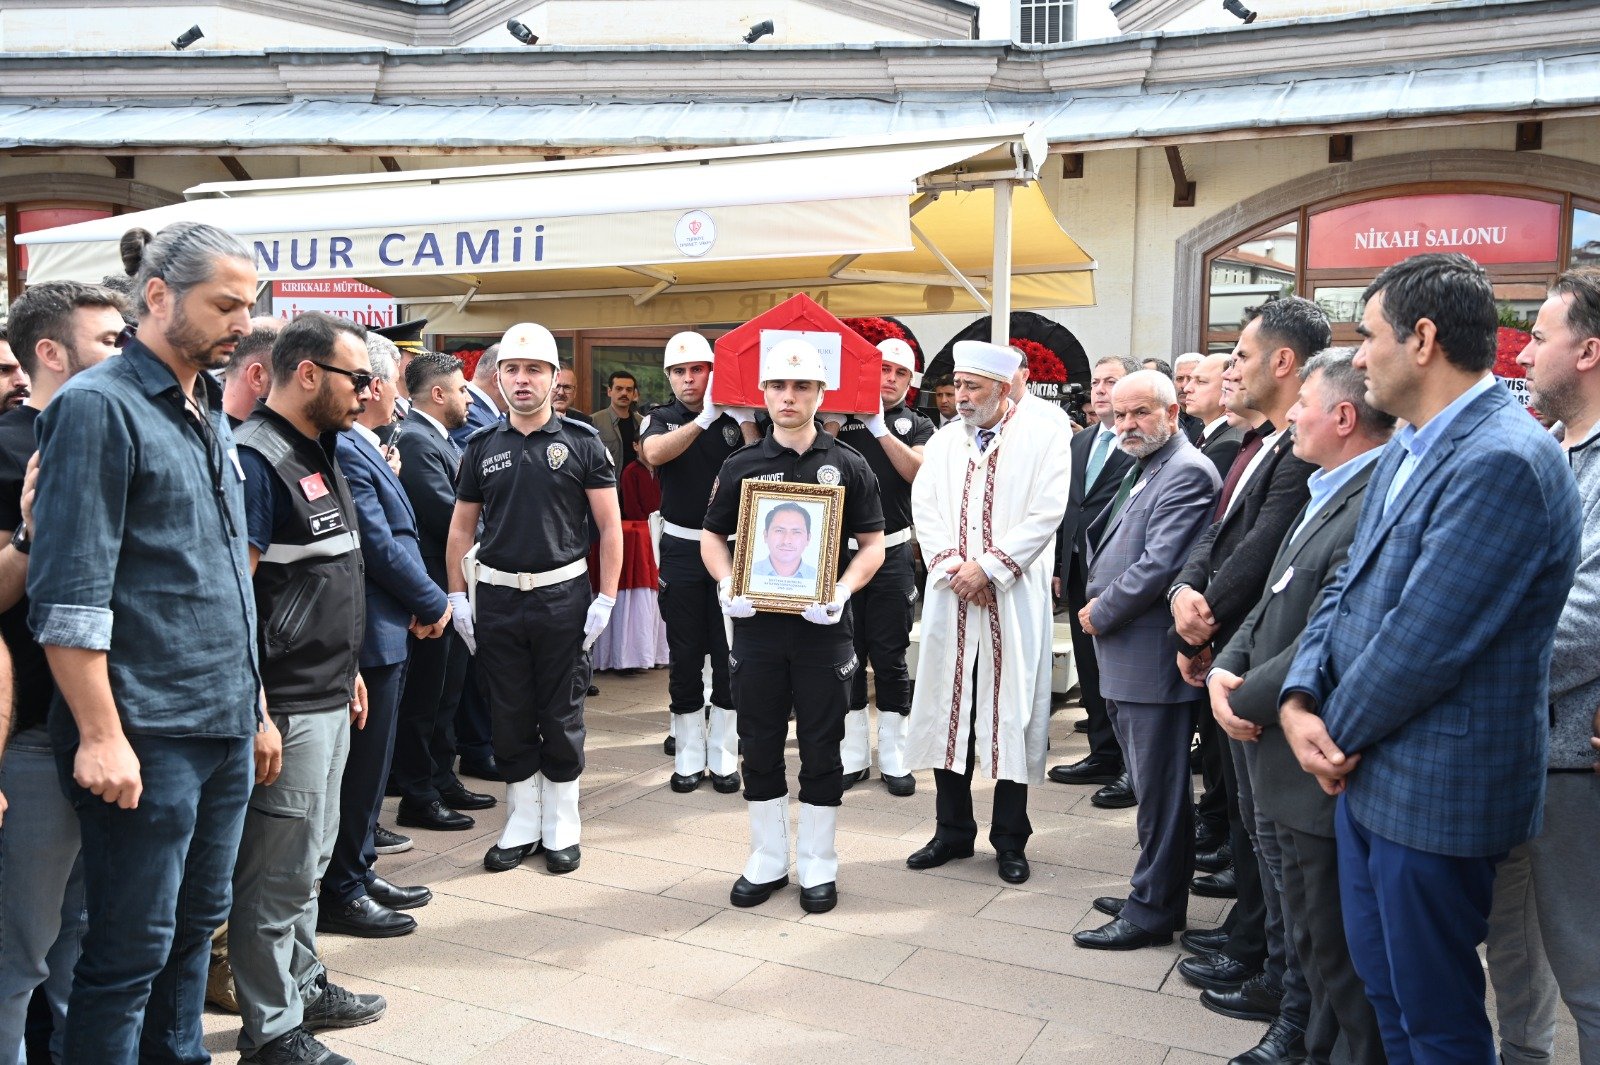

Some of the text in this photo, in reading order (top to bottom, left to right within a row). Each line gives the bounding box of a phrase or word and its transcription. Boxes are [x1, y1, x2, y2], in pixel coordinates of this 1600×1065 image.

[1354, 226, 1508, 250] NİKAH SALONU
[253, 236, 354, 272] NUR
[281, 282, 331, 292] KIRIKKALE
[353, 304, 393, 328] DİNİ
